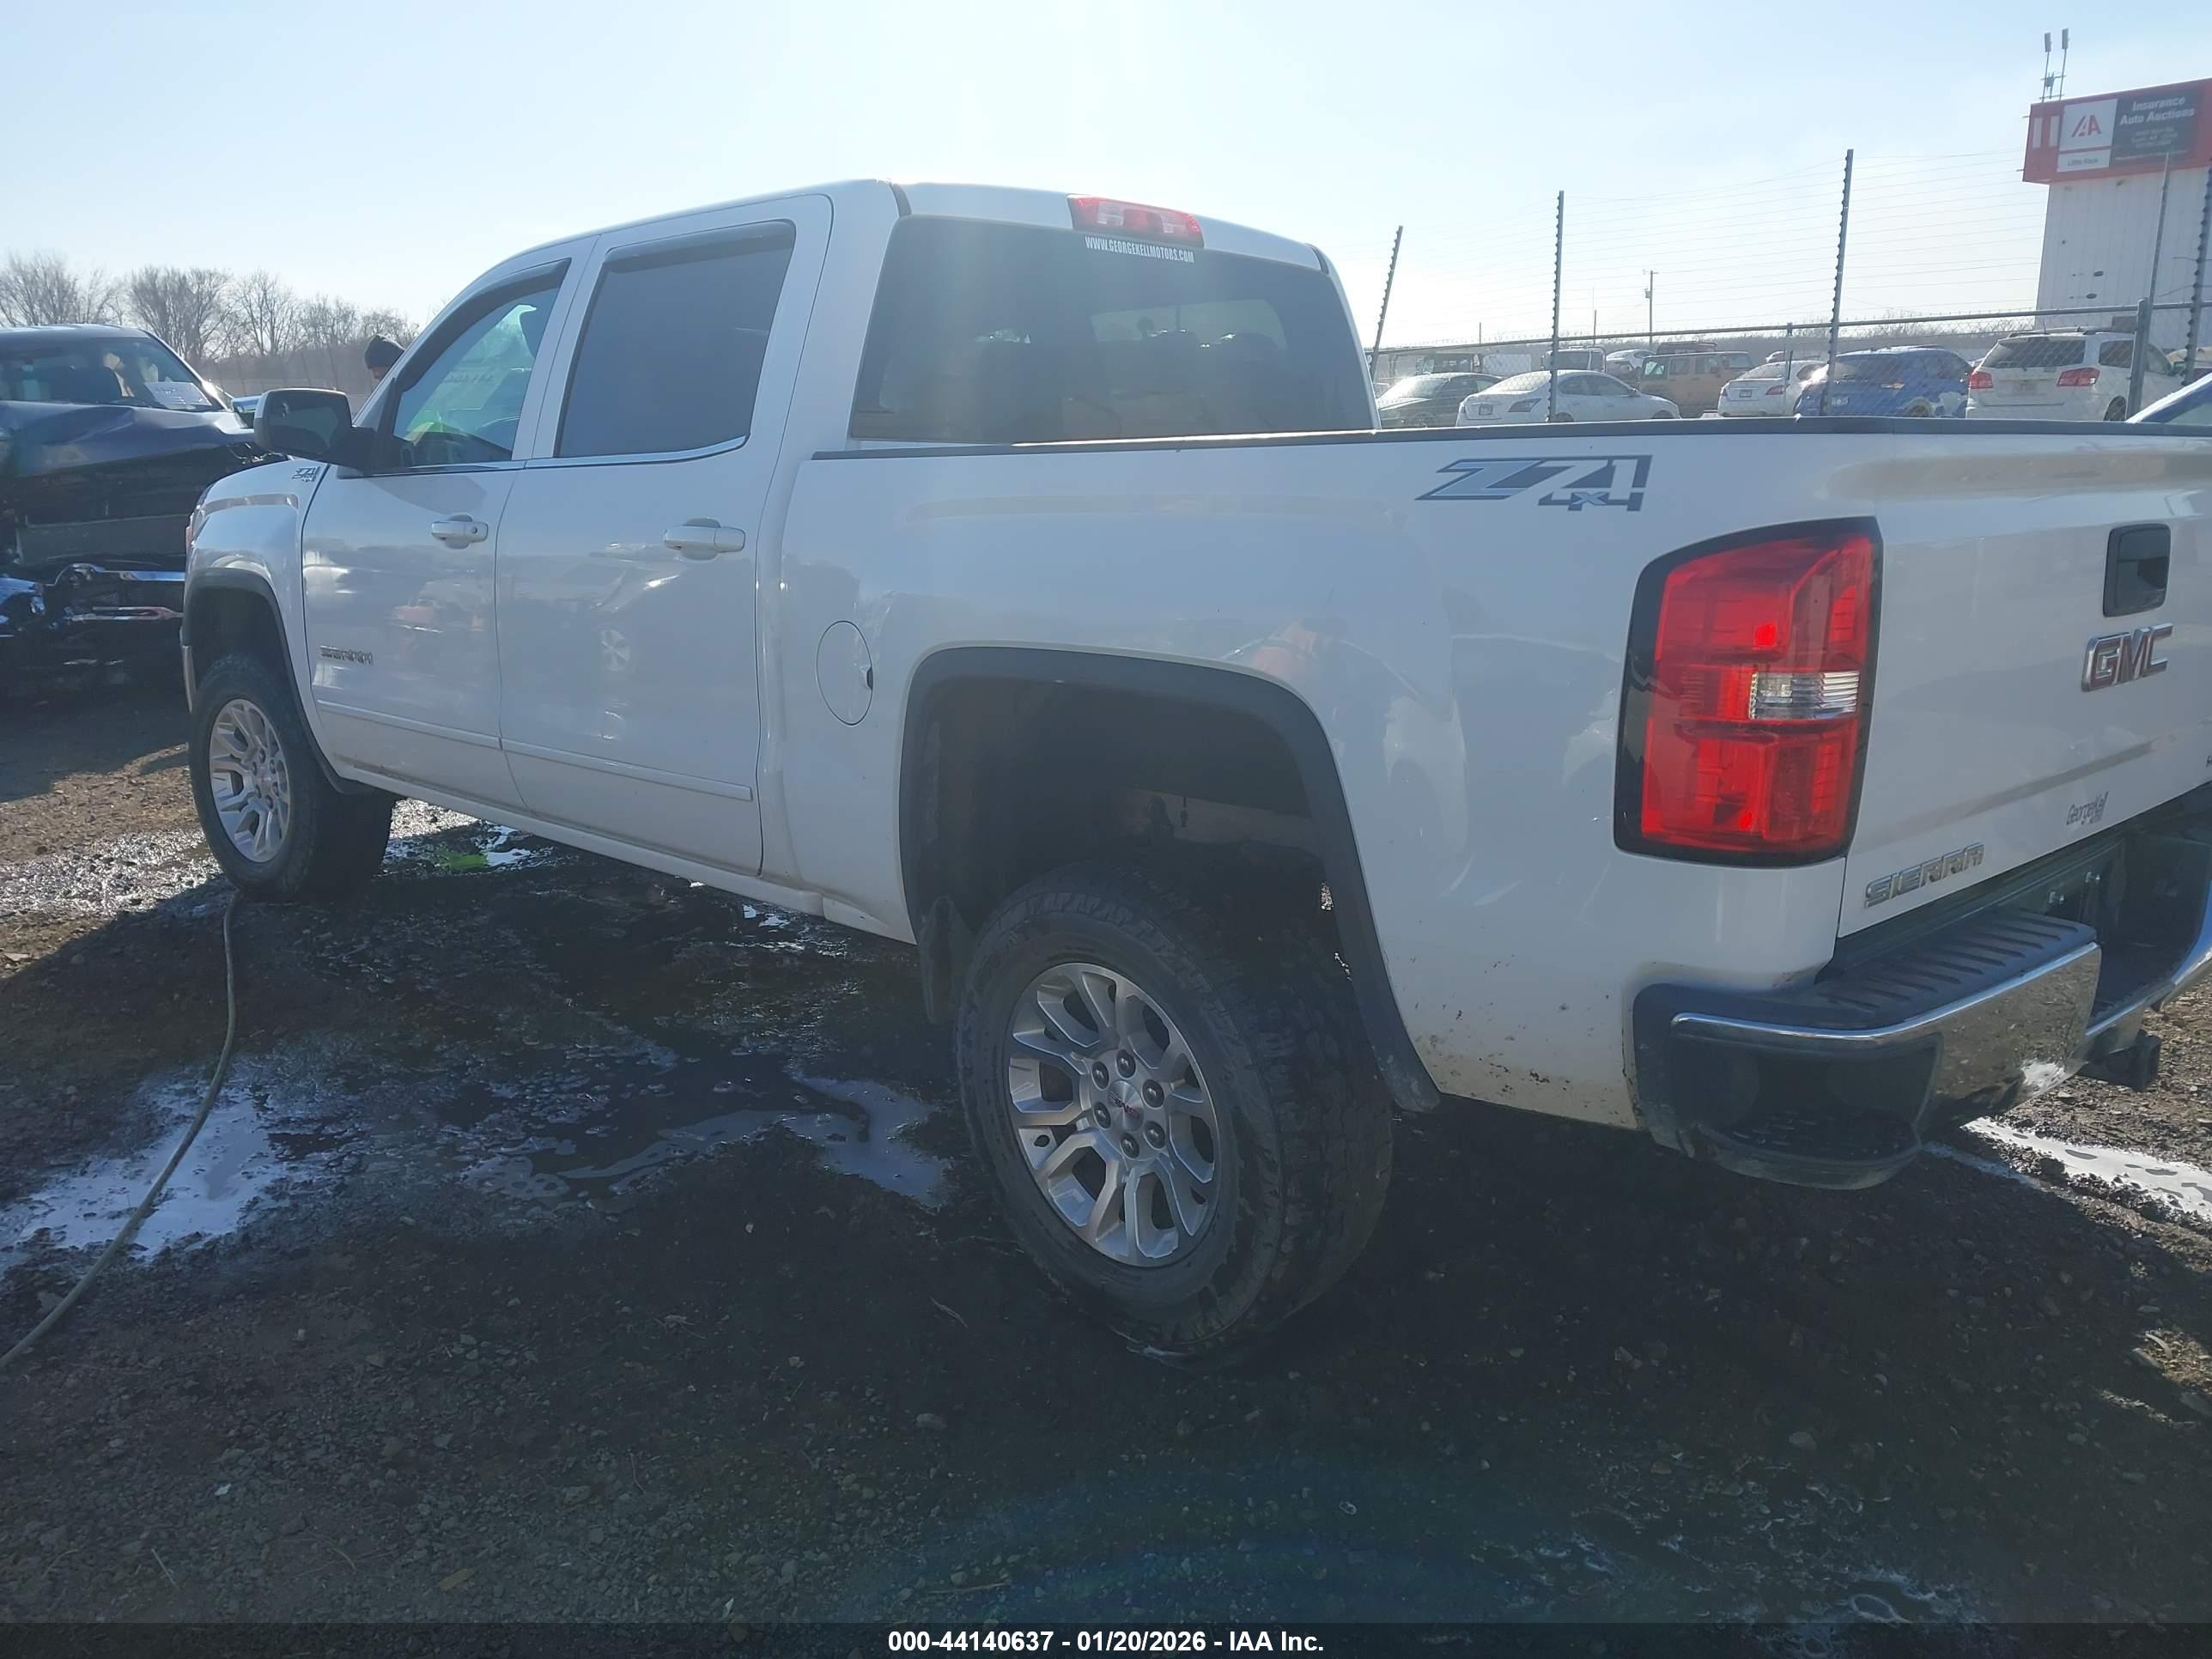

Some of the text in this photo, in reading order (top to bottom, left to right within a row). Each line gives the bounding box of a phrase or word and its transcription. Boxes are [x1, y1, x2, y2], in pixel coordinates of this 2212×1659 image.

[2118, 107, 2197, 126] Auto Auctions
[2131, 95, 2186, 112] Insurance
[1085, 235, 1194, 264] WWW.GEORGEKELLMOTORS.COM
[1413, 454, 1653, 501] Z71
[2081, 623, 2174, 693] GMC
[1863, 842, 1985, 909] SIERRA
